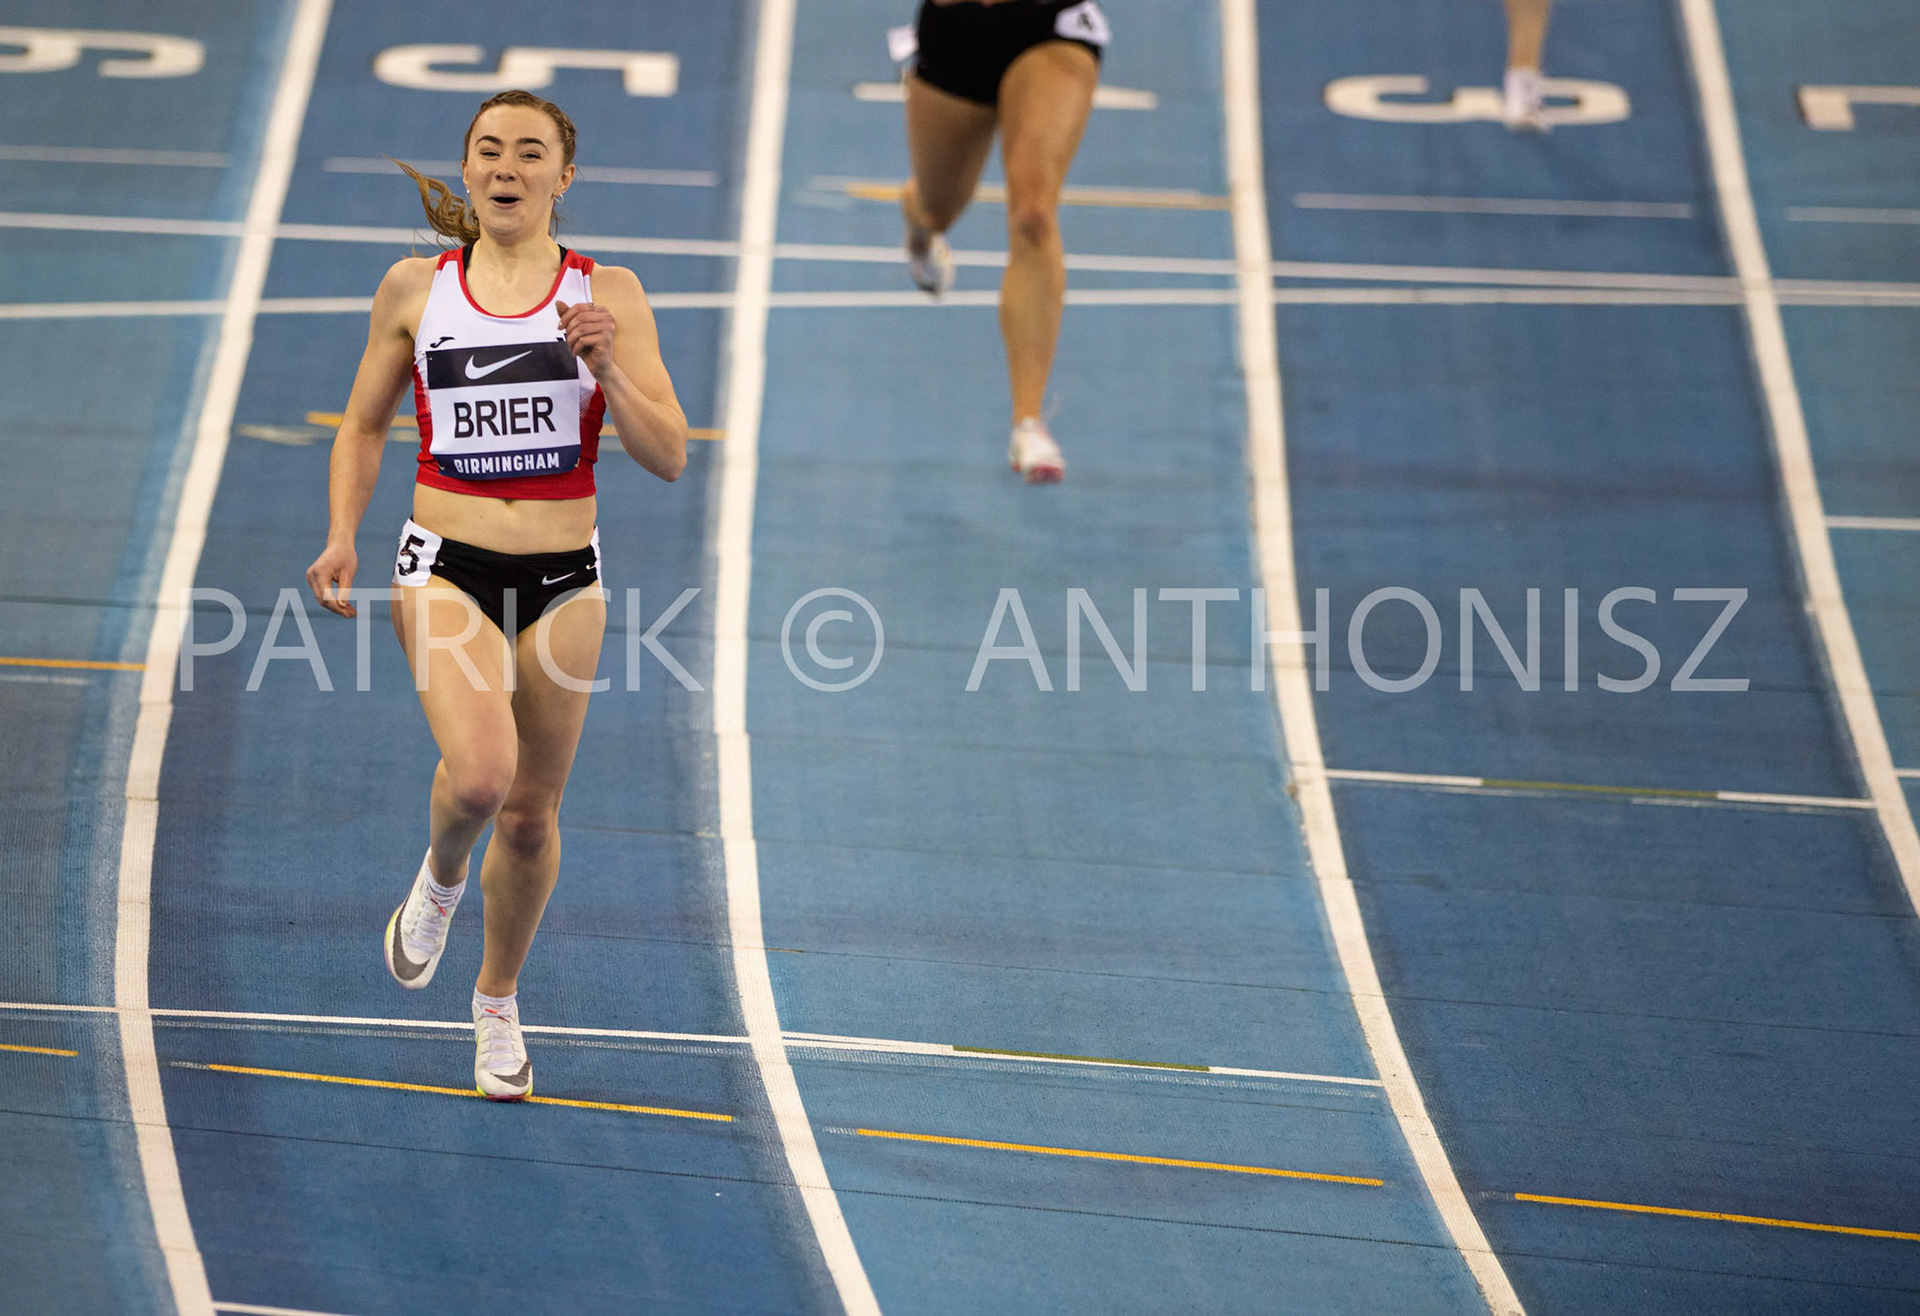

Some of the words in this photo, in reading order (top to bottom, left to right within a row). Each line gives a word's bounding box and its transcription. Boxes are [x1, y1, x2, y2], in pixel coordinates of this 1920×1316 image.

[374, 44, 679, 98] 5
[453, 396, 556, 438] BRIER
[453, 452, 560, 474] BIRMINGHAM
[397, 534, 426, 576] 5
